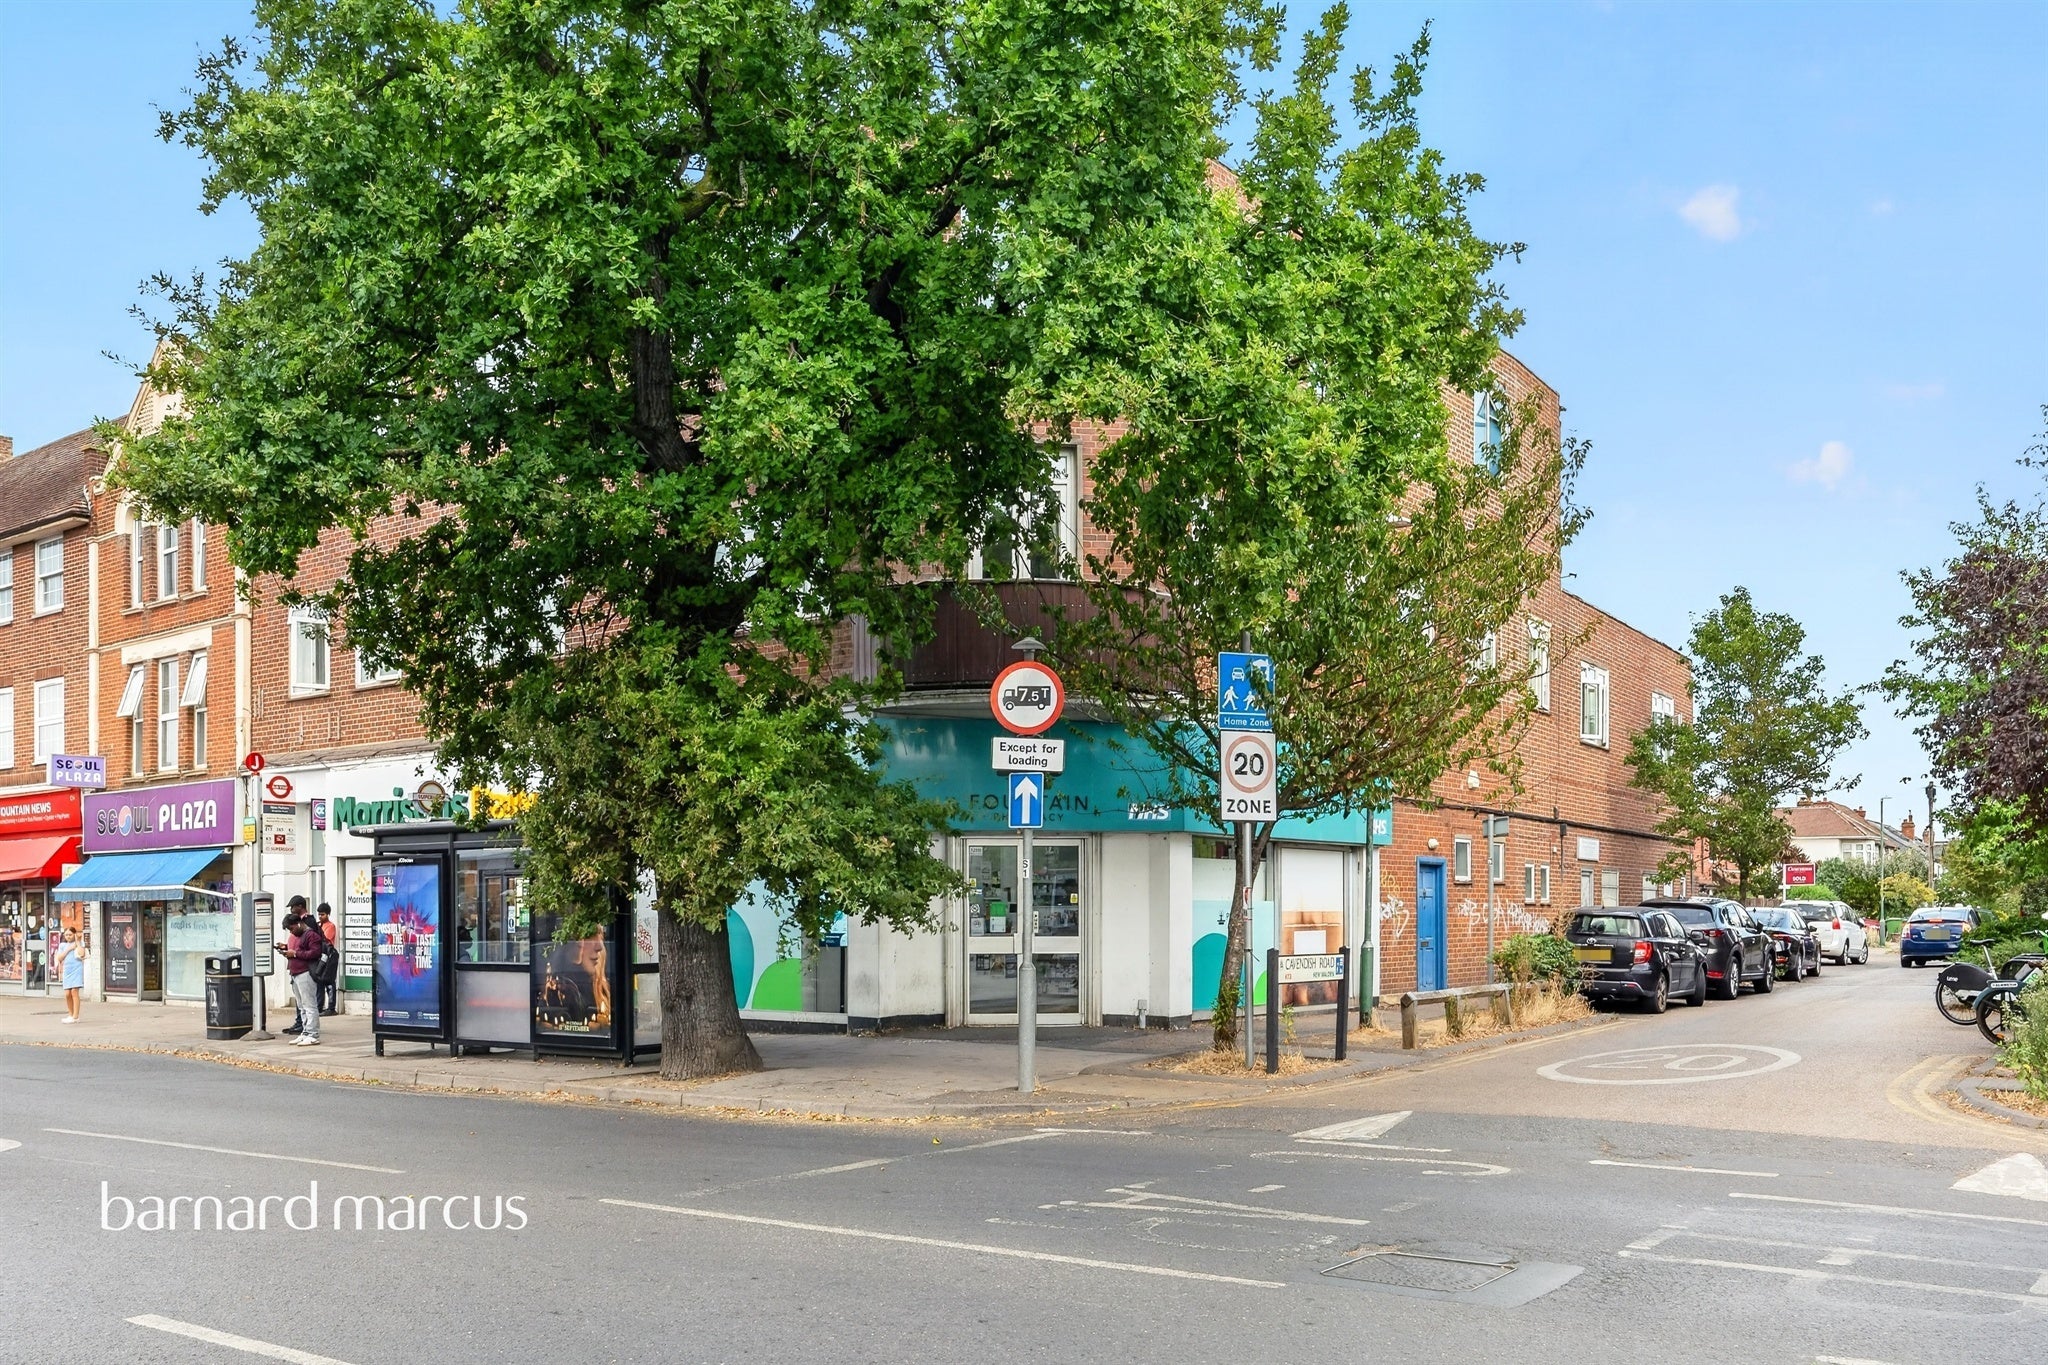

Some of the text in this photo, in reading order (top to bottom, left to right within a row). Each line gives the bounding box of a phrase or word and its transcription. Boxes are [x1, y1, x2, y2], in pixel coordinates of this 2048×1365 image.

[1223, 717, 1270, 727] Home Zone
[999, 741, 1058, 754] Except for
[56, 759, 101, 771] SEOUL
[251, 755, 259, 770] J
[1008, 755, 1048, 768] loading
[1234, 752, 1264, 776] 20
[56, 771, 101, 783] PLAZA
[0, 802, 51, 817] OUNTAIN NEWS
[332, 786, 470, 831] Morriss
[1226, 798, 1272, 814] ZONE
[97, 800, 217, 837] SEOUL PLAZA
[1022, 859, 1029, 869] S
[347, 895, 373, 904] Morriso
[416, 933, 436, 946] TASTE
[415, 956, 433, 969] TIME
[1285, 956, 1335, 970] CAVENDISH ROAD
